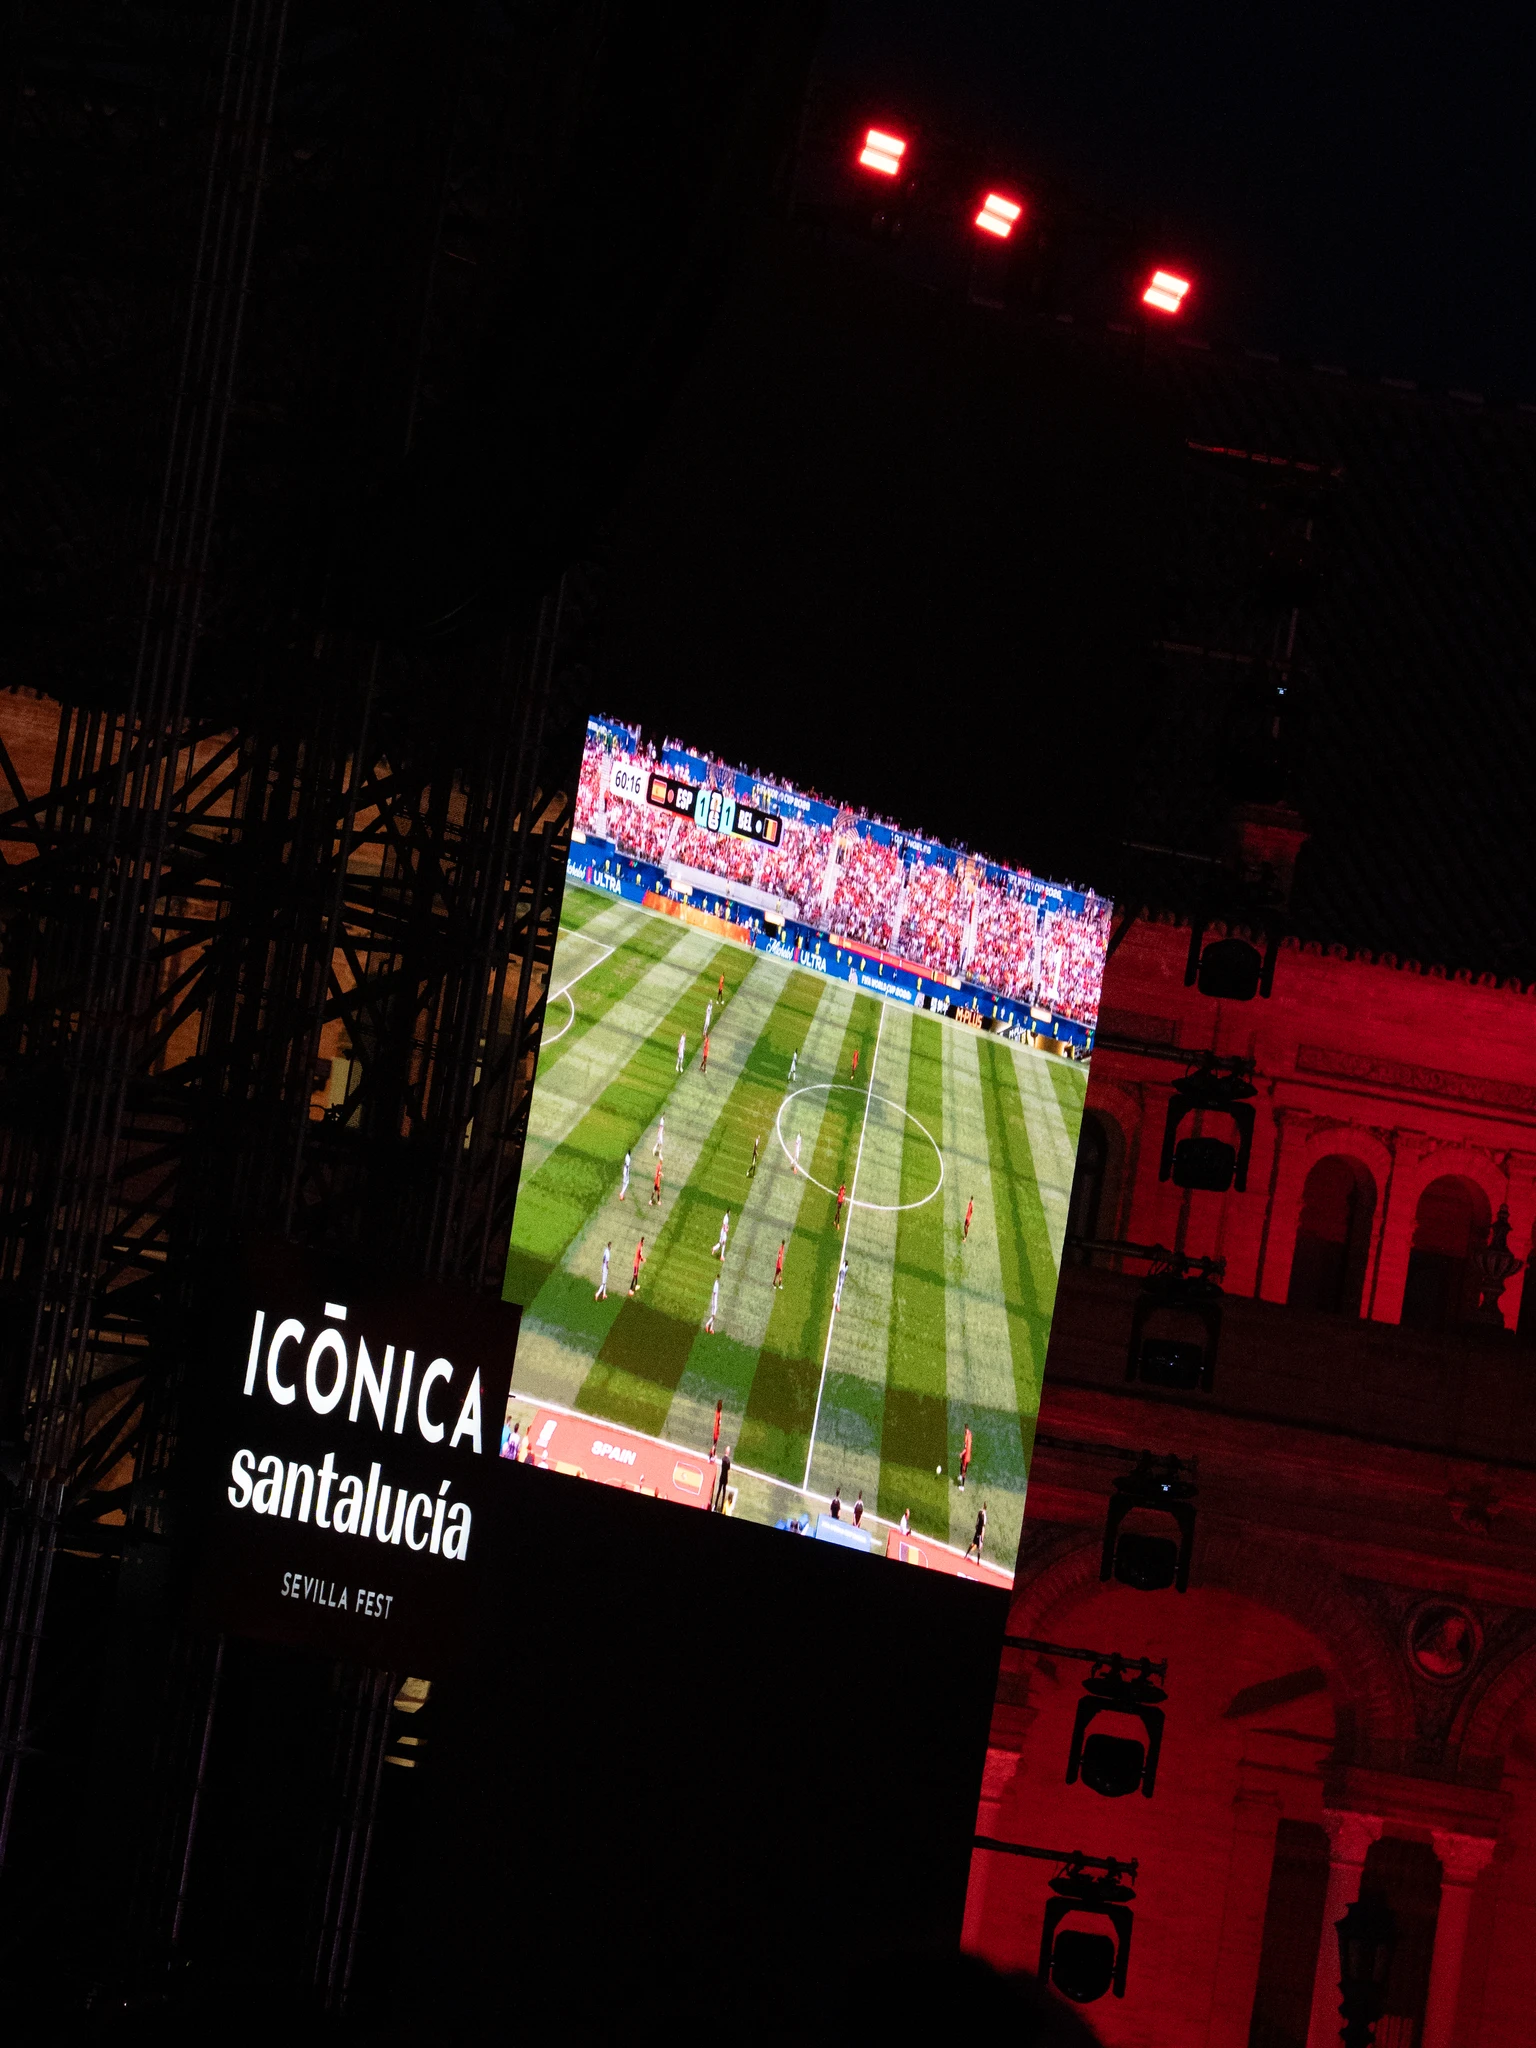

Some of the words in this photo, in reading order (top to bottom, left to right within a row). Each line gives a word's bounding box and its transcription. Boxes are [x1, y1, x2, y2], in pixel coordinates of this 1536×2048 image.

[614, 770, 642, 795] 60:16
[675, 788, 693, 810] ESP
[700, 796, 706, 818] 1
[725, 805, 731, 827] 1
[738, 810, 752, 833] BEL
[593, 869, 622, 895] ULTRA
[800, 949, 827, 973] ULTRA
[955, 1006, 984, 1029] M-PLUS
[591, 1441, 637, 1466] SPAIN
[227, 1449, 472, 1561] santalucía
[280, 1571, 348, 1610] SEVILLA
[355, 1589, 394, 1619] FEST
